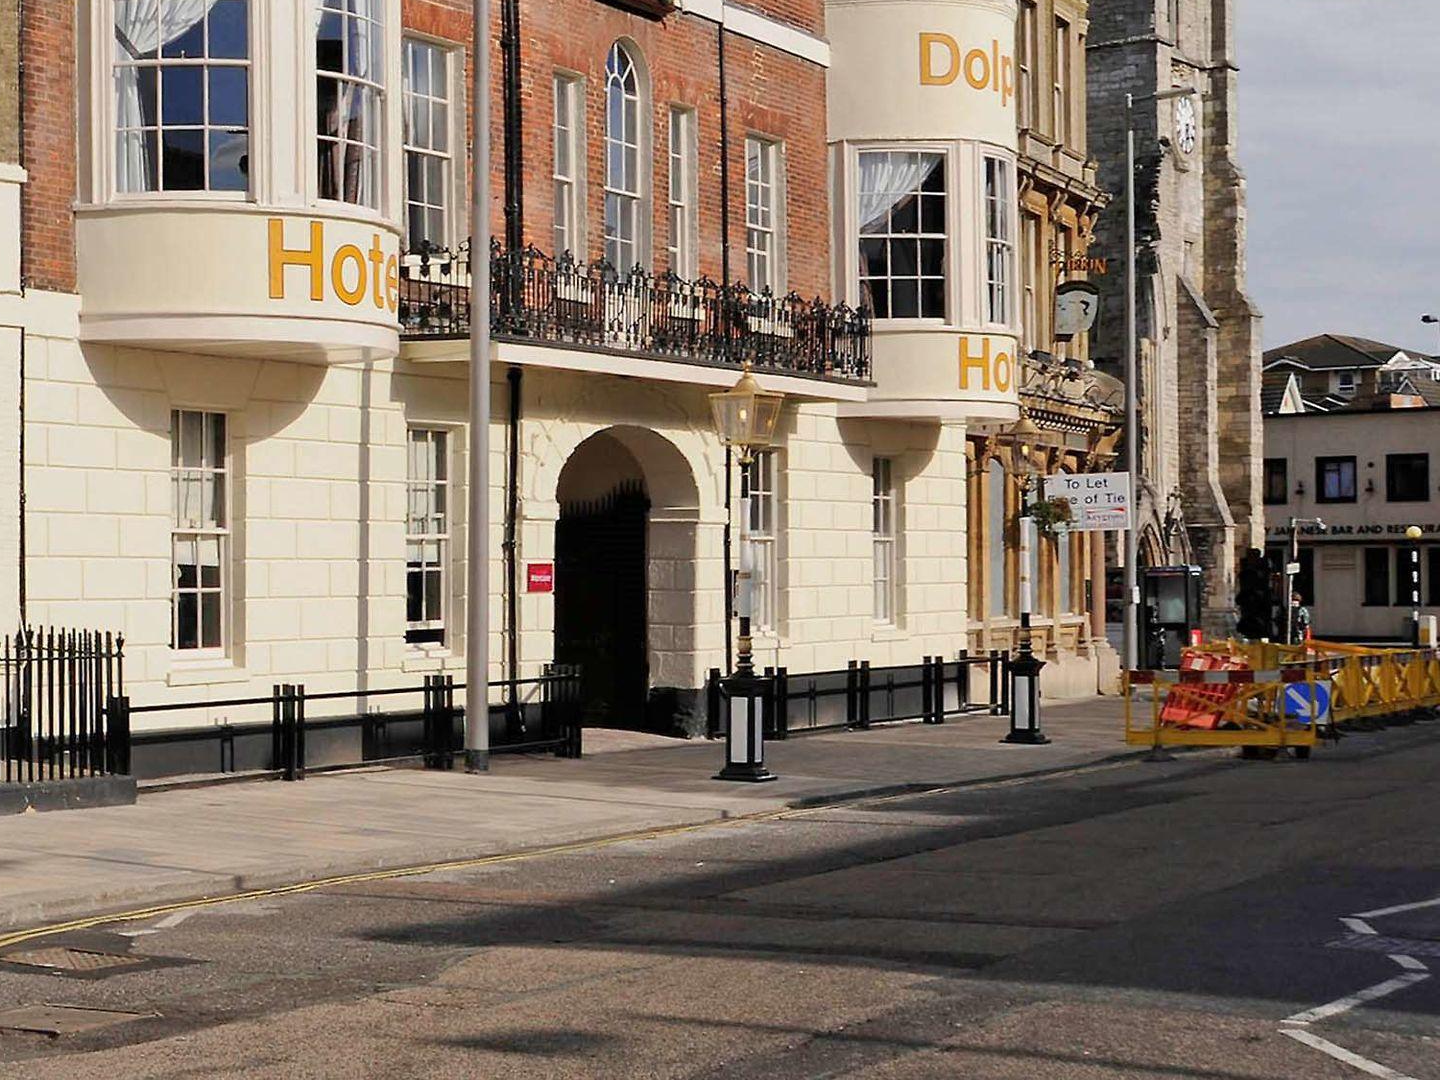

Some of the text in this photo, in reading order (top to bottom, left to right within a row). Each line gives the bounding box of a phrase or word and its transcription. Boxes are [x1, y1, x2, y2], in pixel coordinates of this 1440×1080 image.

[1064, 478, 1108, 489] To Let
[1084, 493, 1097, 504] of
[1104, 492, 1125, 503] Tie
[1332, 524, 1354, 535] BAR
[1357, 524, 1383, 534] AND
